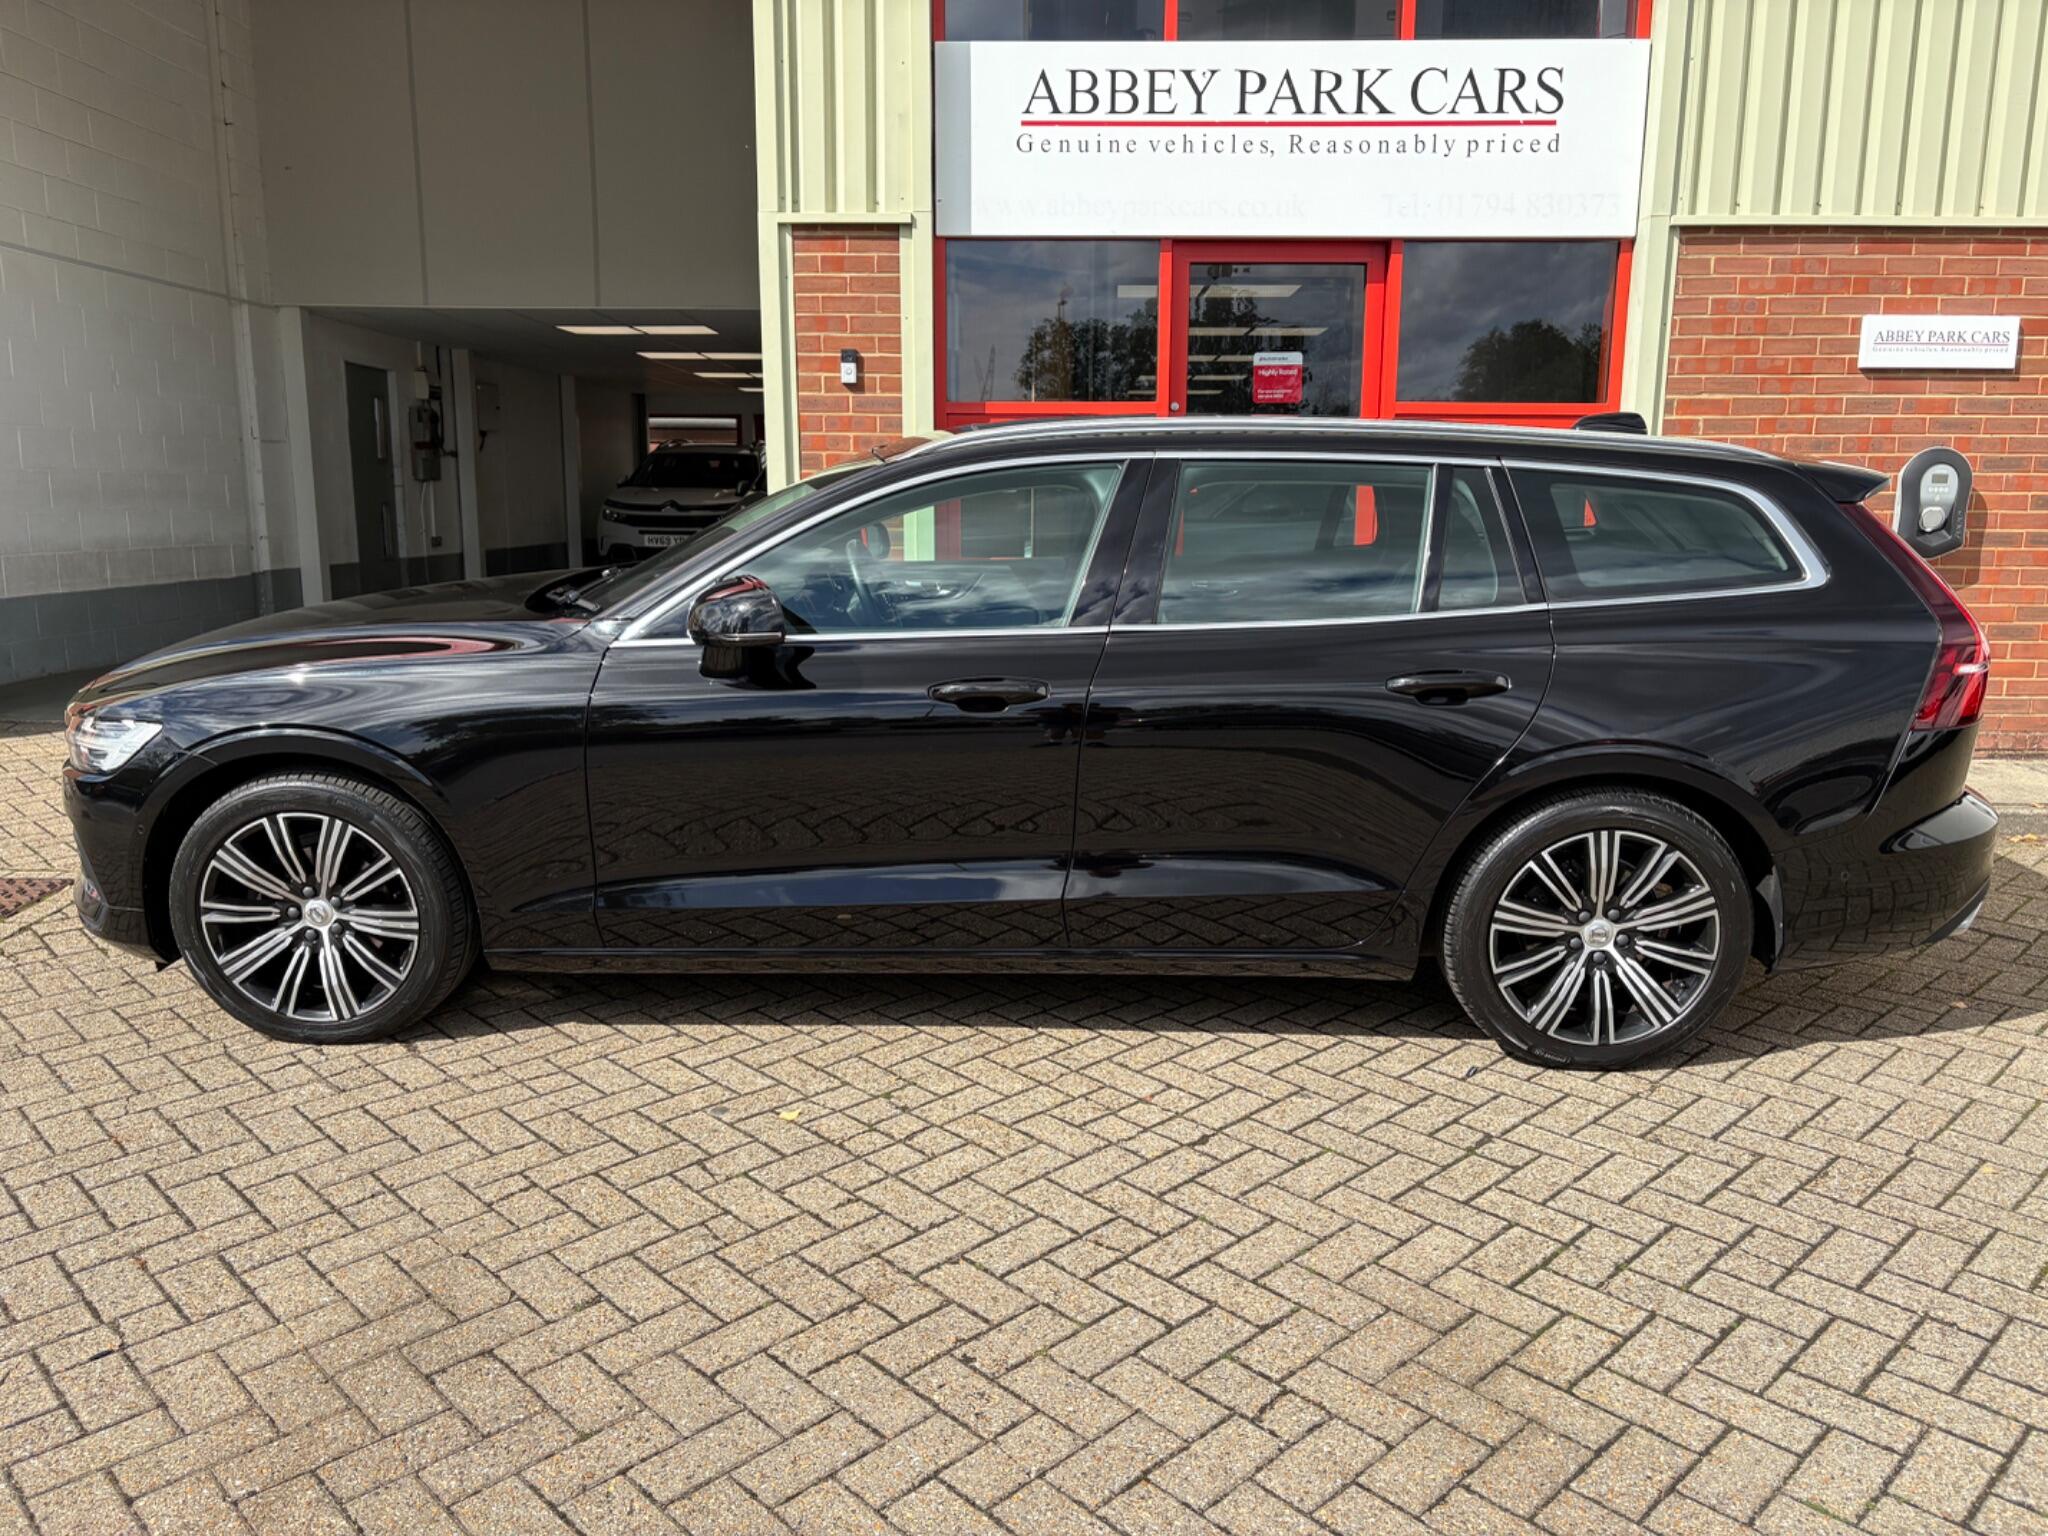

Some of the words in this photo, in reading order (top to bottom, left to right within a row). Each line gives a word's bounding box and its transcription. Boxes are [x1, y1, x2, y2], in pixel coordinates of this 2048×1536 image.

[1022, 68, 1219, 115] ABBEY
[1236, 68, 1395, 115] PARK
[1410, 66, 1564, 116] CARS
[1016, 133, 1137, 154] Genuine
[1148, 133, 1275, 157] vehicles,
[1289, 133, 1456, 158] Reasonably
[1466, 132, 1560, 158] priced
[1874, 330, 1925, 342] ABBEY
[1928, 330, 1967, 343] PARK
[1971, 331, 2010, 343] CARS
